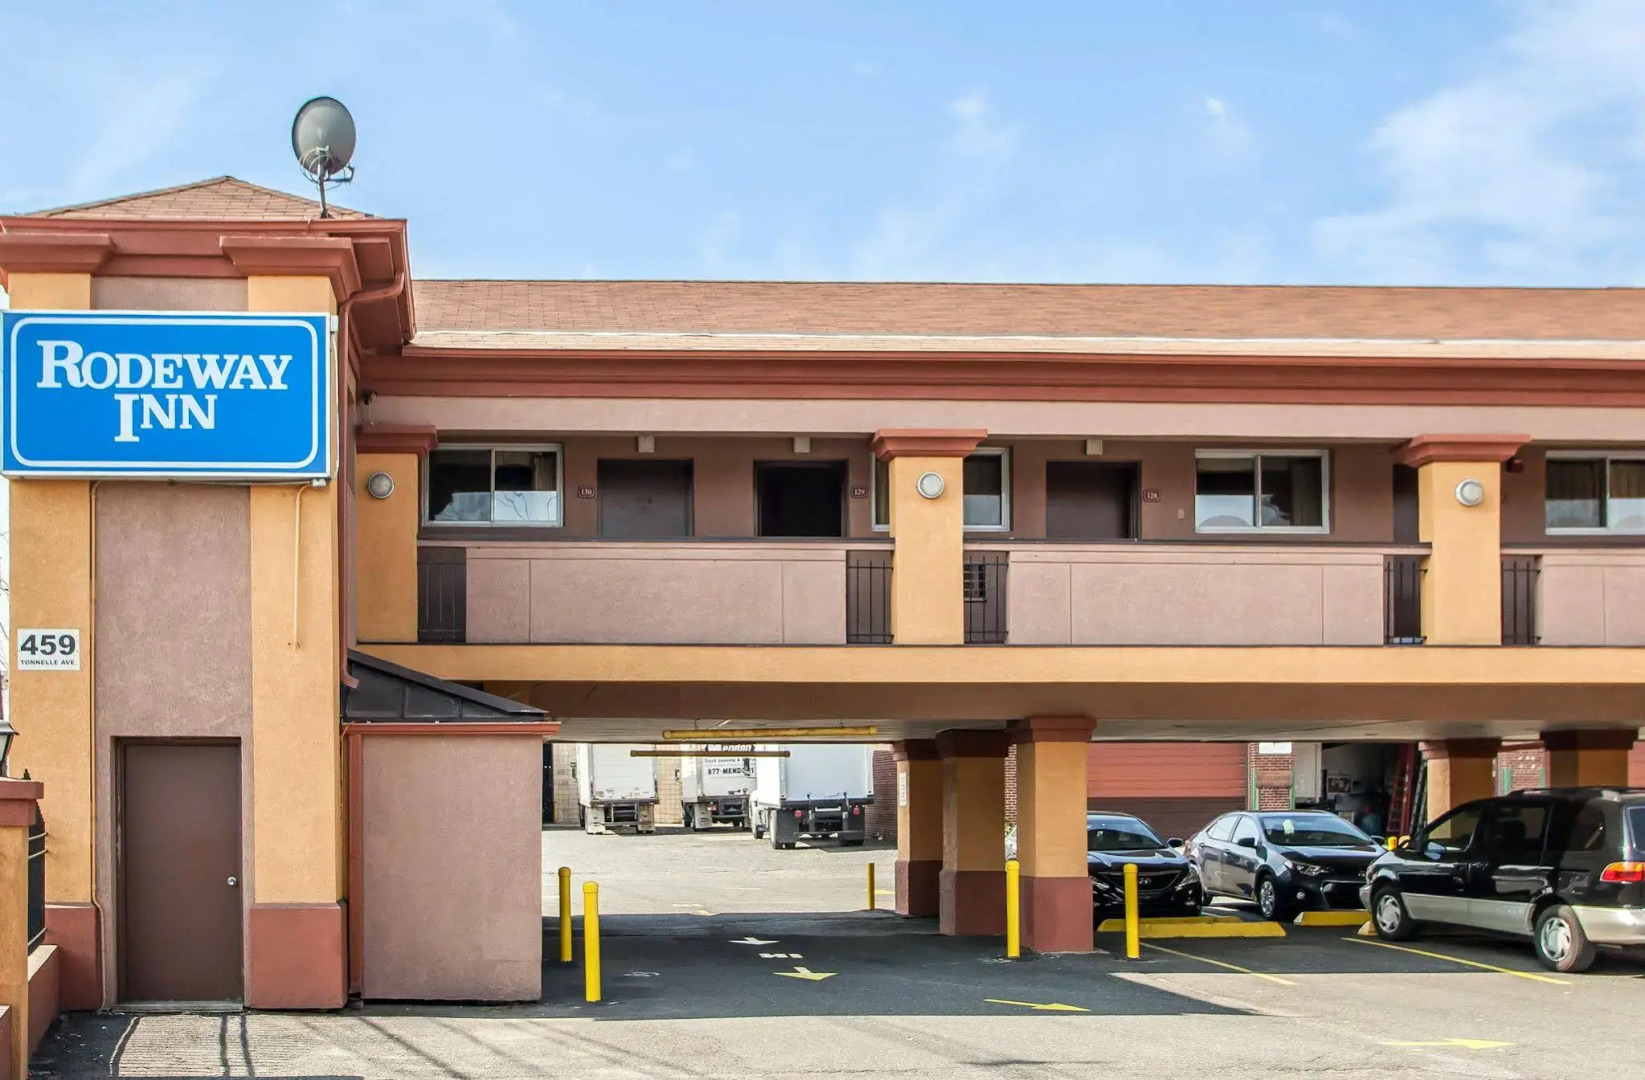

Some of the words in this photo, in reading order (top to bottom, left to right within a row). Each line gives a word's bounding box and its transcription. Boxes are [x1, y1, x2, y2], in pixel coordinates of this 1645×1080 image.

[36, 340, 293, 389] RODEWAY
[114, 393, 218, 442] INN
[20, 634, 76, 656] 459
